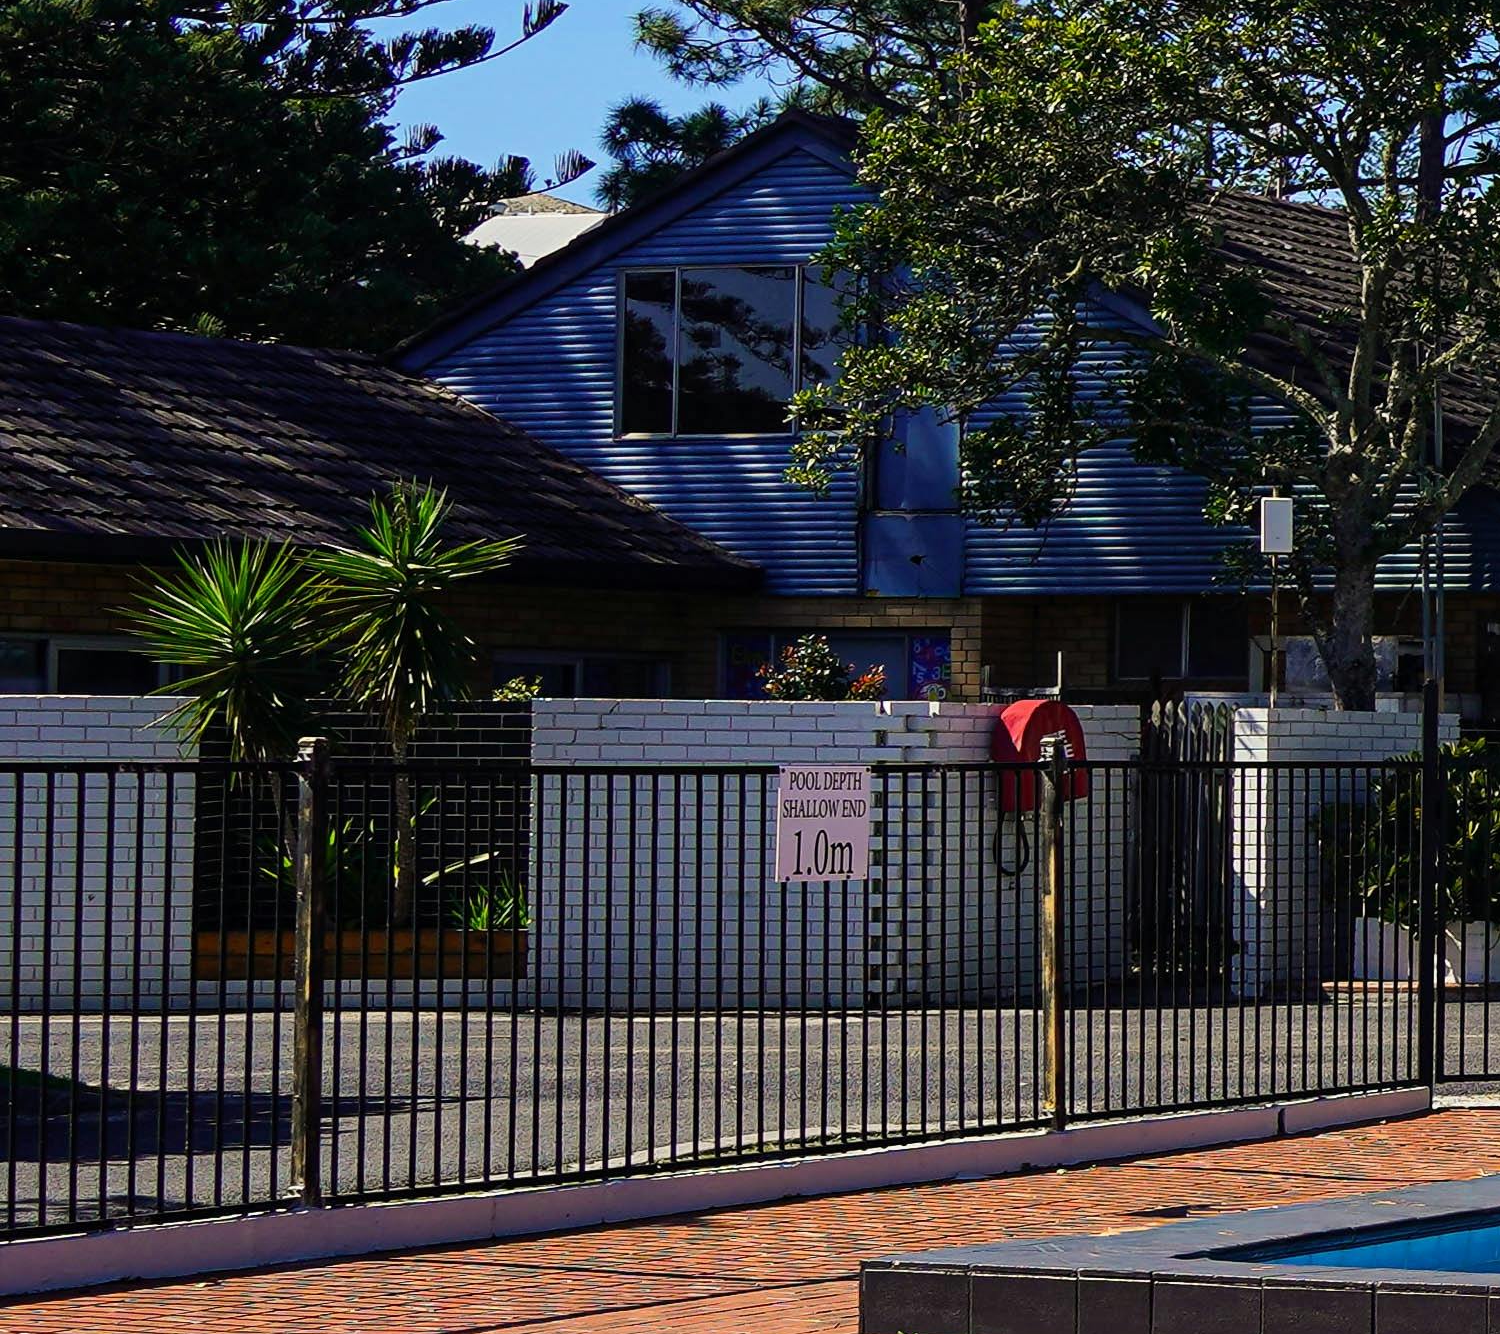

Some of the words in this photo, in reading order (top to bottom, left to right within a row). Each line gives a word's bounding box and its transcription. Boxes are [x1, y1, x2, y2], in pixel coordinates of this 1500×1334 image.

[789, 771, 820, 790] POOL
[823, 771, 862, 790] DEPTH
[783, 799, 839, 818] SHALLOW
[842, 799, 866, 818] END
[793, 829, 854, 875] 1.0m
